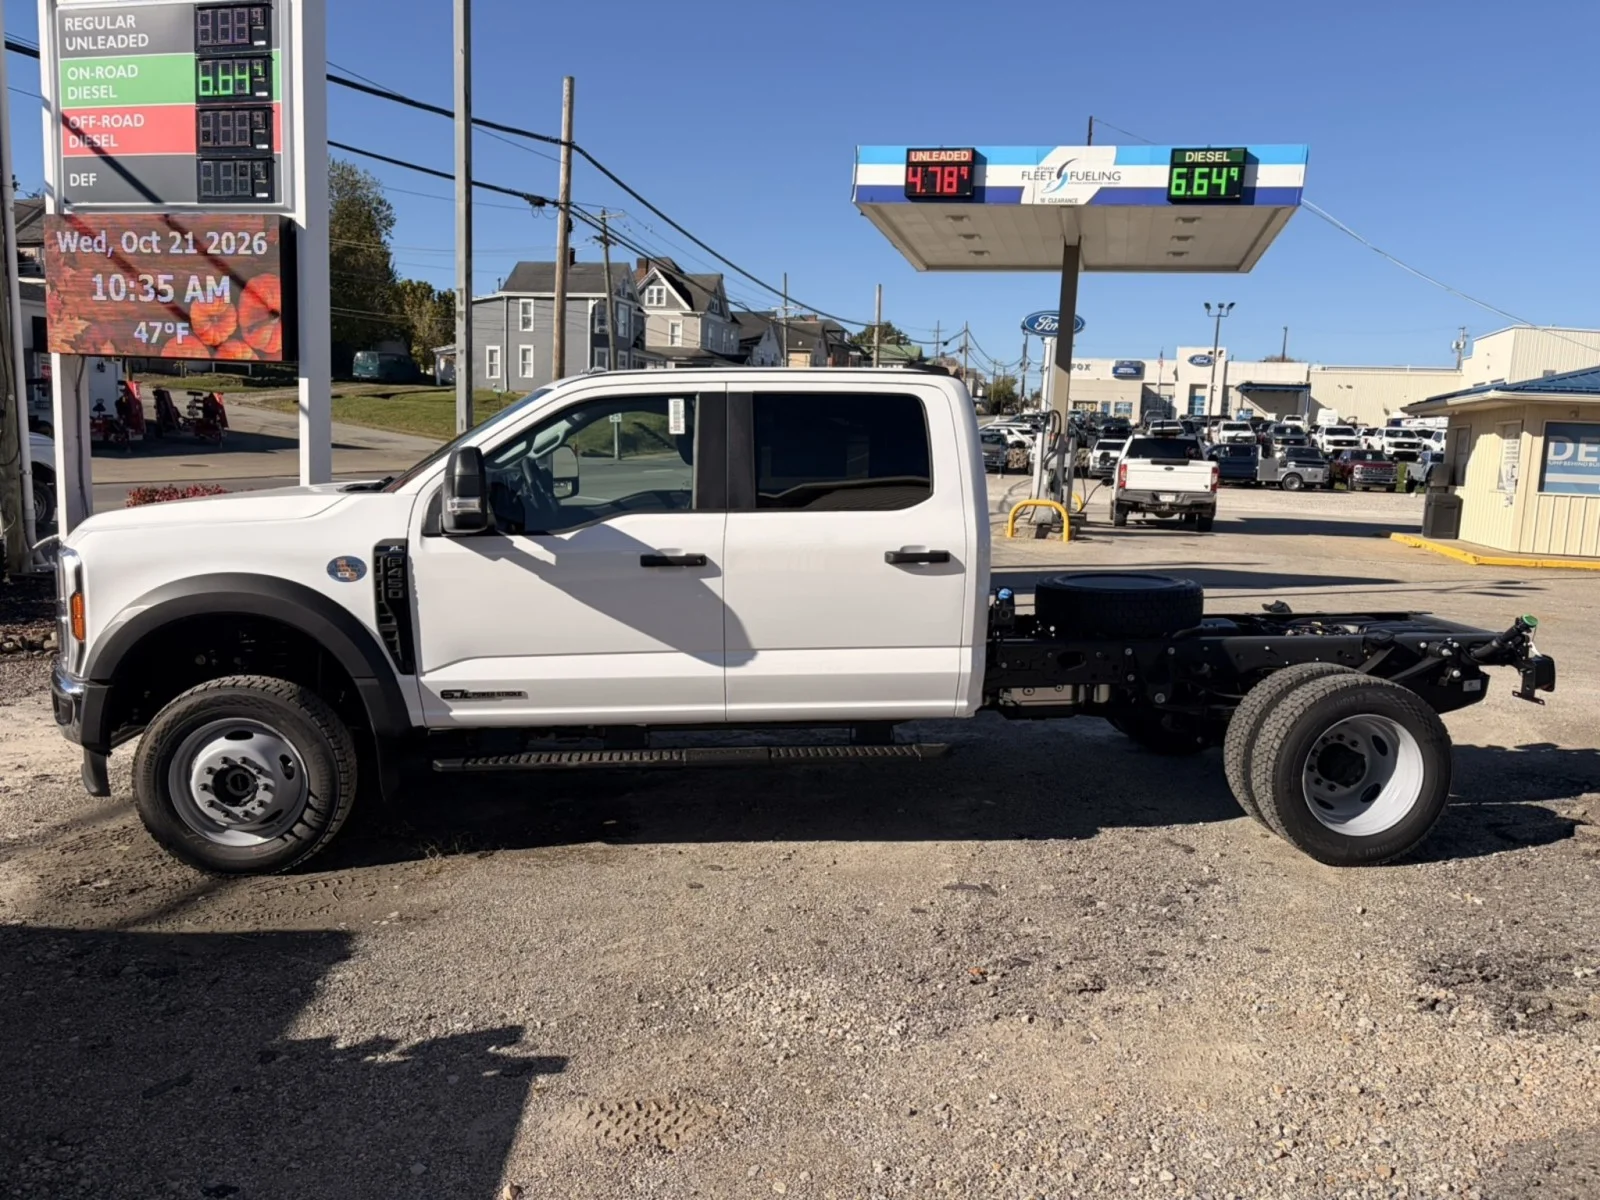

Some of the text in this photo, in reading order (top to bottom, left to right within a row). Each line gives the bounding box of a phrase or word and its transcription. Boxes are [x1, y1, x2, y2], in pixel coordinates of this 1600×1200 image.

[64, 15, 136, 32] REGULAR
[65, 34, 149, 51] UNLEADED
[67, 65, 138, 80] ON-ROAD
[67, 85, 118, 100] DIESEL
[69, 113, 145, 129] OFF-ROAD
[69, 134, 119, 149] DIESEL
[911, 151, 970, 162] UNLEADED
[1185, 152, 1231, 162] DIESEL
[70, 173, 97, 187] DEF
[1021, 171, 1122, 182] FLEET FUELING
[56, 230, 268, 257] Wed, Oct 21 2026
[91, 273, 231, 304] 10:35 AM
